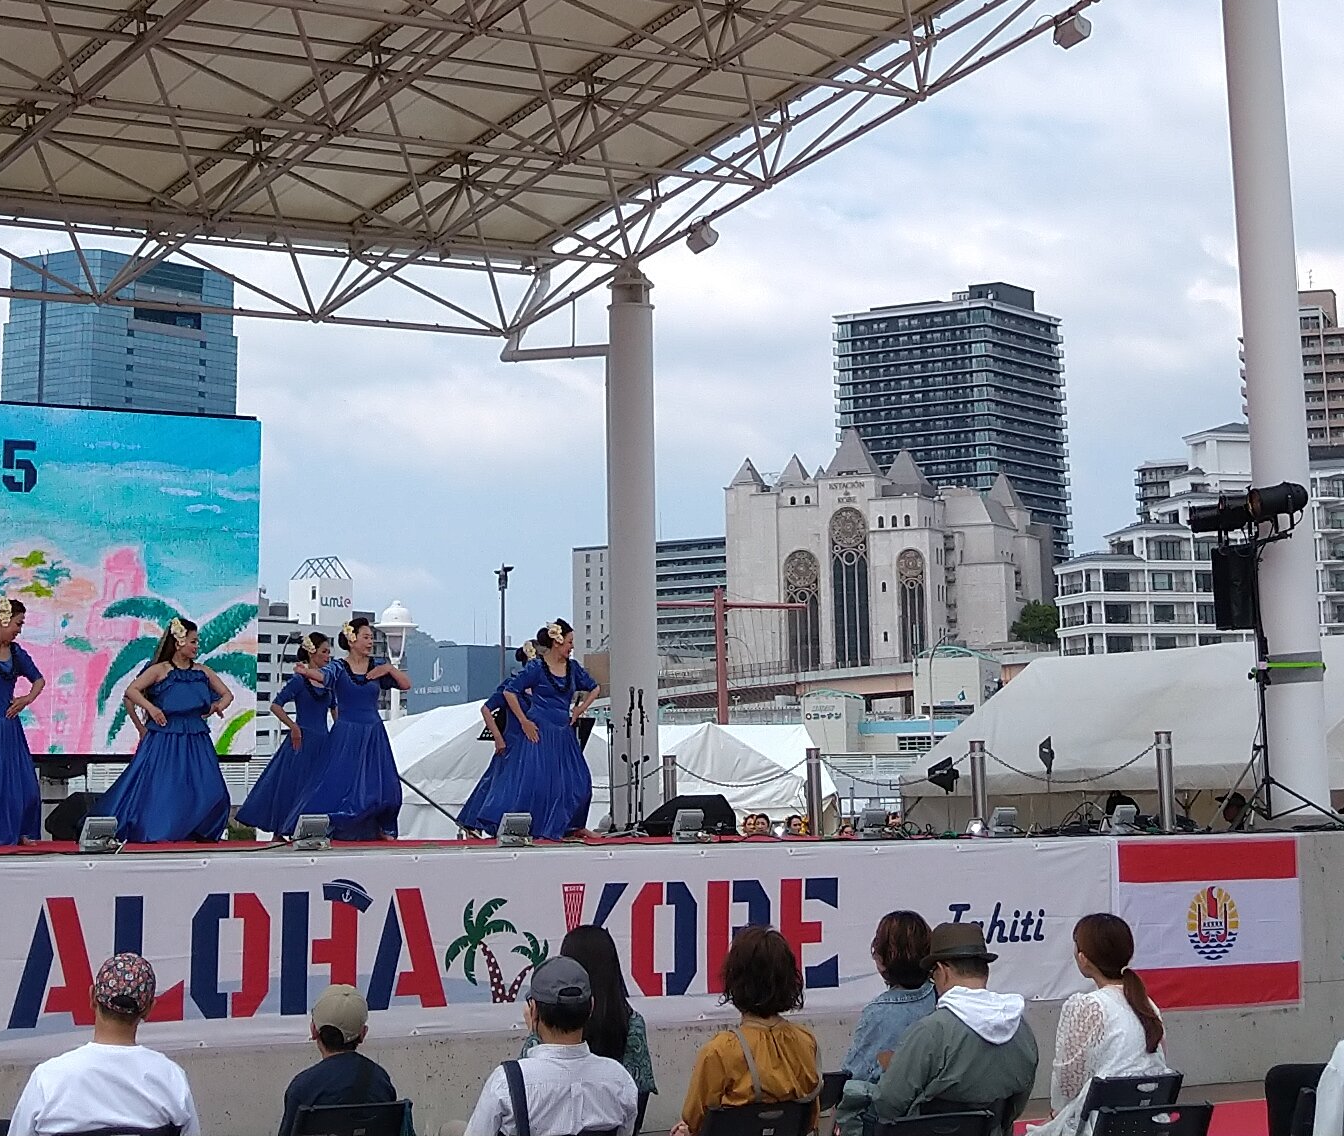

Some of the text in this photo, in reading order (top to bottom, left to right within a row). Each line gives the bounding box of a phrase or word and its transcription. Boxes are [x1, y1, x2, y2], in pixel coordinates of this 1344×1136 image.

[320, 595, 352, 608] umie
[948, 902, 1046, 944] Thiti
[7, 887, 448, 1030] ALOHA
